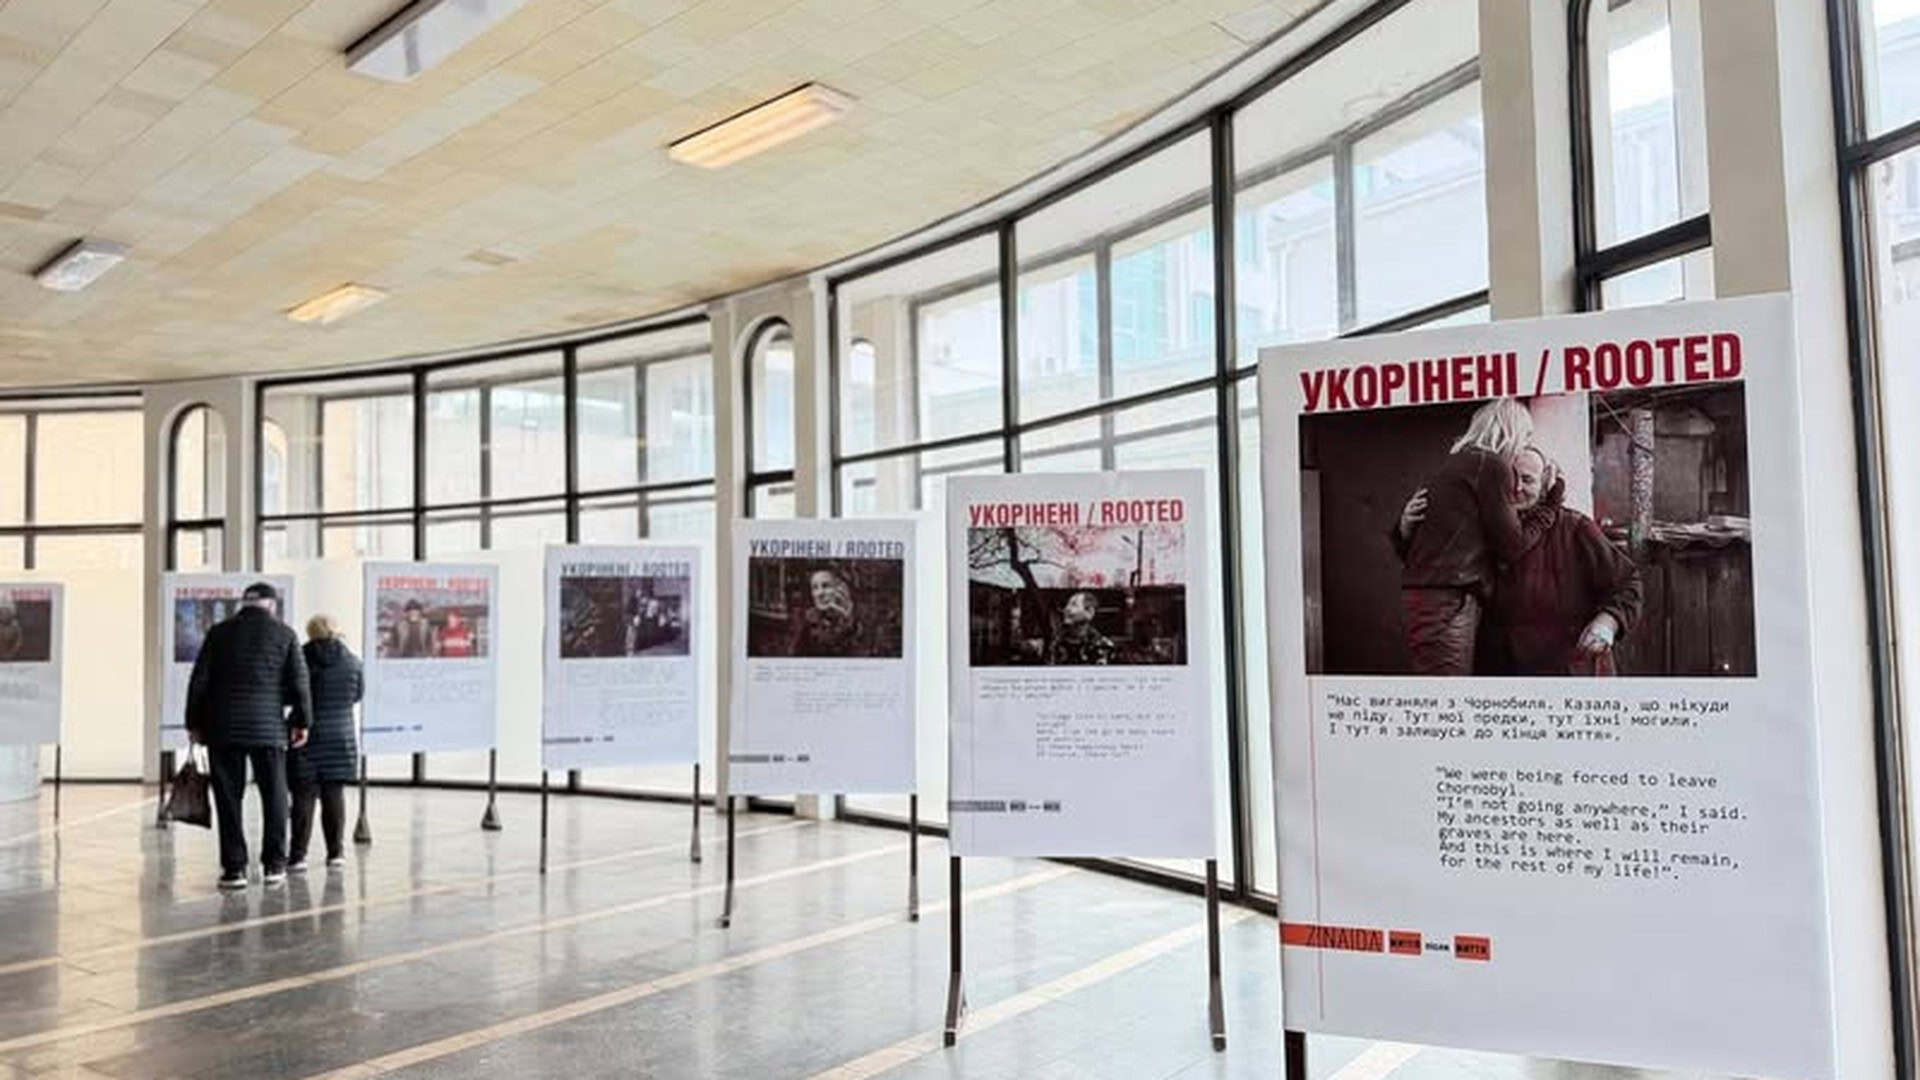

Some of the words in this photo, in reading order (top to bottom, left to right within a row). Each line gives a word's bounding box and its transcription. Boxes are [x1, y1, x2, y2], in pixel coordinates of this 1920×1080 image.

[1299, 352, 1518, 412] УКОРІНЕНІ
[1535, 349, 1551, 396] /
[1564, 332, 1742, 392] ROOTED
[969, 502, 1079, 526] УКОРІНЕНІ
[1101, 500, 1183, 523] ROOTED
[1464, 697, 1554, 711] Чорнобиля.
[1564, 698, 1629, 713] Казала,
[1670, 698, 1729, 714] нікуди
[1353, 708, 1393, 724] піду.
[1404, 710, 1430, 725] Тут
[1474, 712, 1535, 726] предки,
[1547, 714, 1574, 727] тут
[1631, 716, 1698, 728] могили.
[1345, 725, 1370, 737] тут
[1397, 726, 1467, 740] залишуся
[1474, 728, 1493, 740] до
[1502, 727, 1547, 741] кінця
[1471, 770, 1508, 782] were
[1516, 769, 1563, 786] being
[1572, 770, 1628, 786] forced
[1639, 774, 1658, 786] to
[1669, 773, 1717, 788] leave
[1436, 781, 1524, 798] Chornobyl.
[1481, 800, 1508, 812] not
[1517, 800, 1564, 816] going
[1680, 805, 1688, 818] I
[1699, 806, 1747, 820] said.
[1437, 811, 1455, 826] My
[1464, 812, 1545, 828] ancestors
[1555, 818, 1573, 829] as
[1582, 817, 1619, 832] well
[1631, 821, 1650, 833] as
[1660, 820, 1709, 834] their
[1438, 827, 1491, 841] graves
[1501, 829, 1528, 841] are
[1537, 830, 1581, 844] here.
[1439, 841, 1466, 853] And
[1475, 842, 1510, 855] this
[1520, 844, 1537, 857] is
[1546, 846, 1593, 860] where
[1604, 847, 1611, 860] I
[1622, 849, 1659, 864] will
[1670, 852, 1739, 869] remain,
[1440, 854, 1466, 868] for
[1475, 857, 1501, 869] the
[1511, 860, 1546, 872] rest
[1556, 861, 1574, 874] of
[1584, 864, 1603, 878] my
[1305, 925, 1383, 952] ZINAIDA
